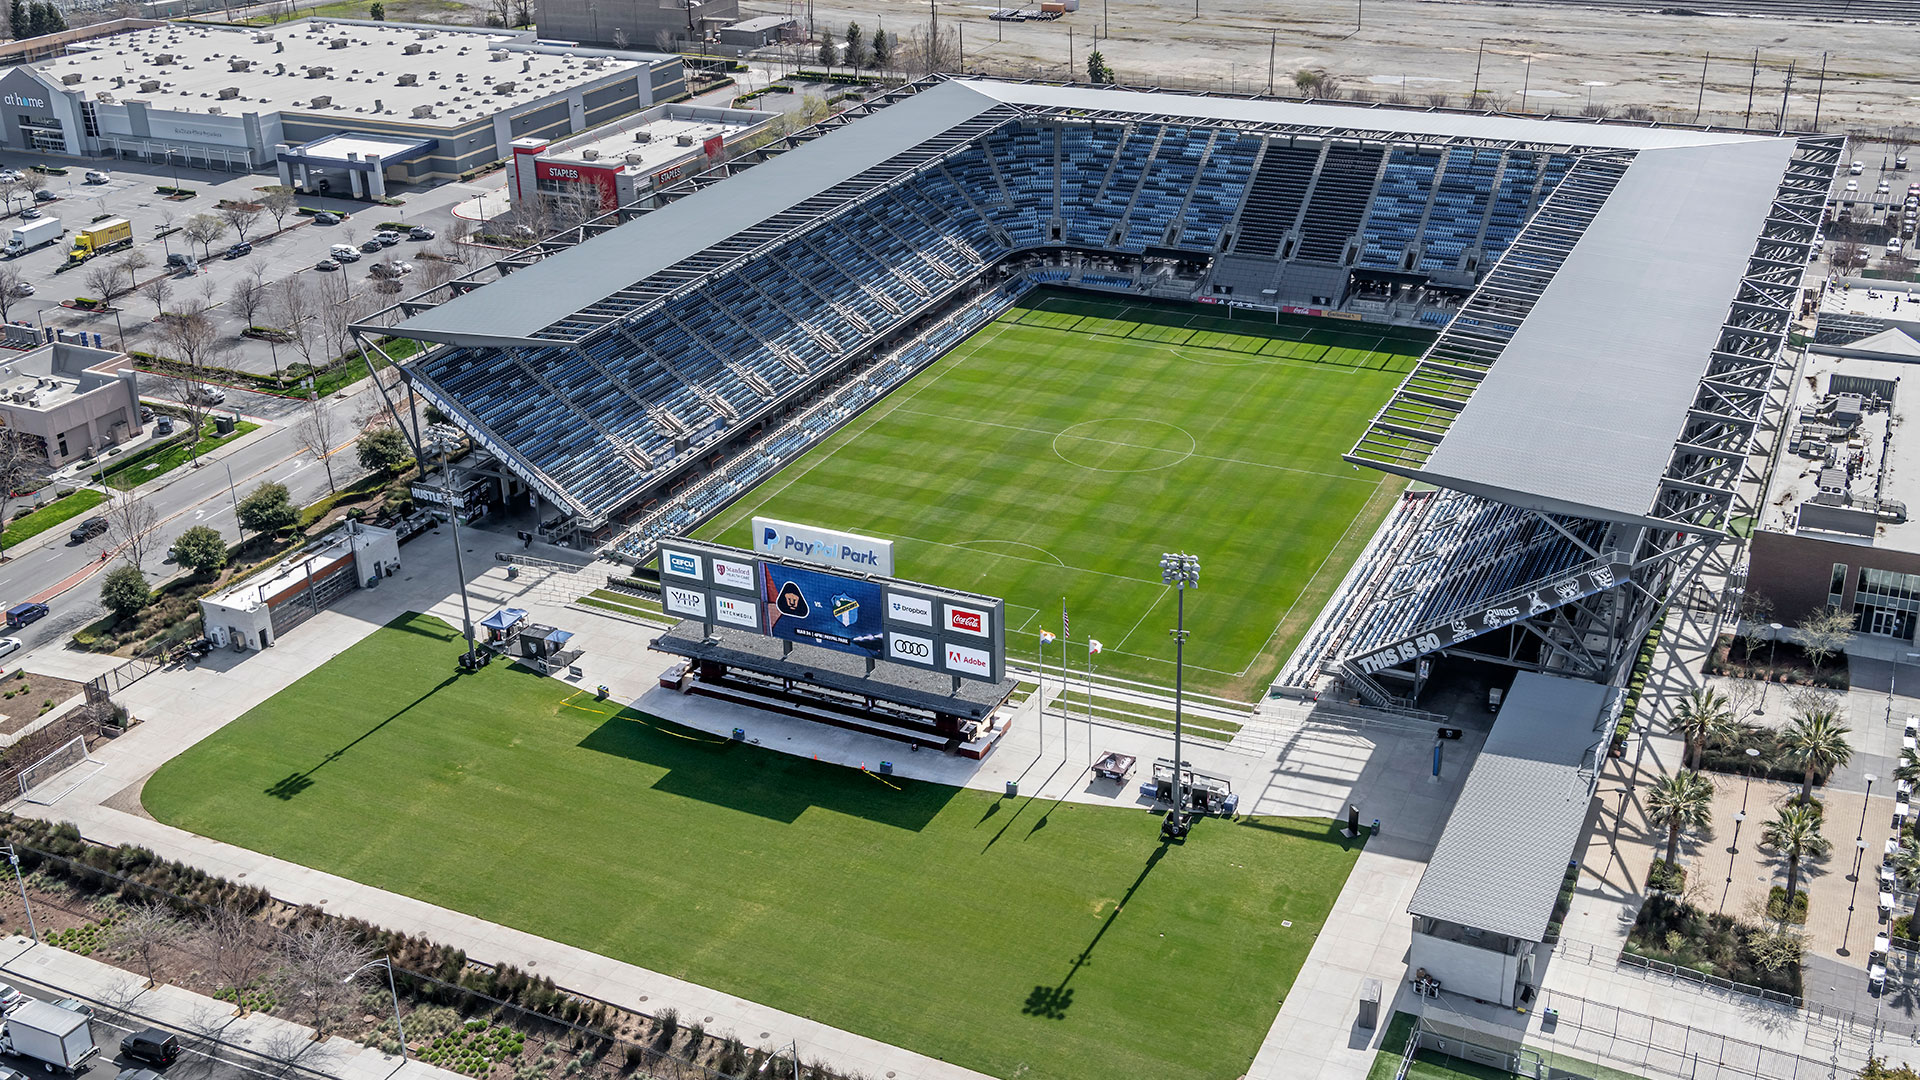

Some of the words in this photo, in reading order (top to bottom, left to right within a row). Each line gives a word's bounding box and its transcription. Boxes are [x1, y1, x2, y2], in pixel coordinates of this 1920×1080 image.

[4, 93, 15, 105] at
[549, 167, 579, 179] STAPLES
[660, 167, 682, 183] STAPLES
[410, 377, 438, 405] HOME
[436, 399, 450, 414] OF
[450, 408, 468, 430] THE
[466, 424, 487, 446] SAN
[485, 440, 509, 464] JOSE
[507, 457, 573, 516] EARTHQUAKES
[411, 487, 443, 503] HUSTLE
[785, 535, 838, 558] PayPal
[841, 545, 878, 566] Park
[671, 557, 694, 568] CEFCU
[726, 565, 750, 576] Stanford
[719, 609, 753, 620] INTERMEDIA
[901, 605, 928, 616] Dropbox
[1486, 606, 1520, 617] QUAKES
[953, 613, 979, 628] Coca-Cola
[1357, 648, 1399, 674] THIS
[1397, 641, 1417, 660] IS
[1415, 633, 1440, 653] 50
[963, 656, 986, 668] Adobe
